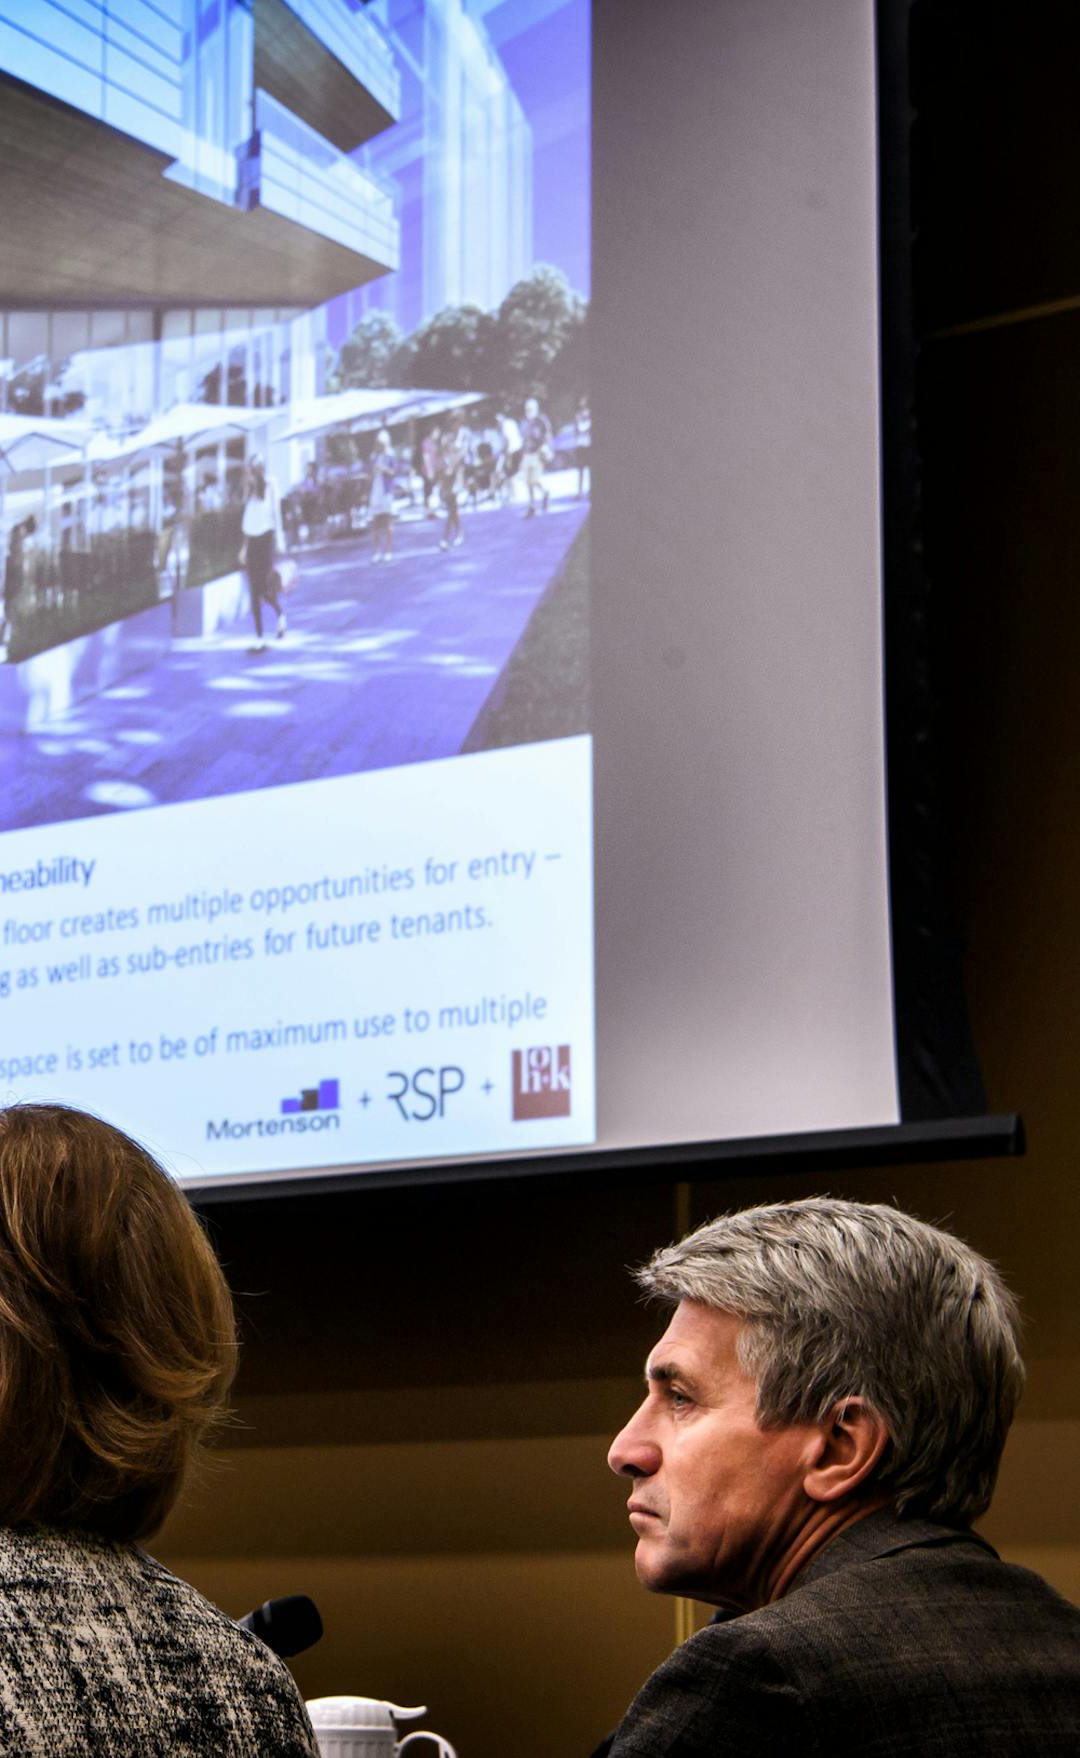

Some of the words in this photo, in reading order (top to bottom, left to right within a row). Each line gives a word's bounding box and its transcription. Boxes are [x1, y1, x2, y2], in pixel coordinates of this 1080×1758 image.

[4, 917, 52, 945] floor
[60, 904, 139, 938] creates
[148, 890, 244, 924] multiple
[249, 867, 414, 915] opportunities
[425, 856, 457, 887] for
[468, 848, 535, 880] entry
[16, 966, 38, 988] as
[45, 955, 91, 984] well
[97, 956, 120, 978] as
[127, 934, 254, 972] sub-entries
[264, 927, 297, 956] for
[306, 918, 381, 951] future
[390, 904, 493, 940] tenants.
[66, 1044, 83, 1071] is
[88, 1042, 120, 1068] set
[129, 1038, 153, 1063] to
[160, 1032, 187, 1061] be
[194, 1026, 218, 1057] of
[225, 1015, 347, 1054] maximum
[354, 1010, 395, 1039] use
[404, 1006, 430, 1032] to
[438, 992, 548, 1029] multiple
[206, 1112, 340, 1141] Mortenson
[387, 1065, 465, 1122] RSP
